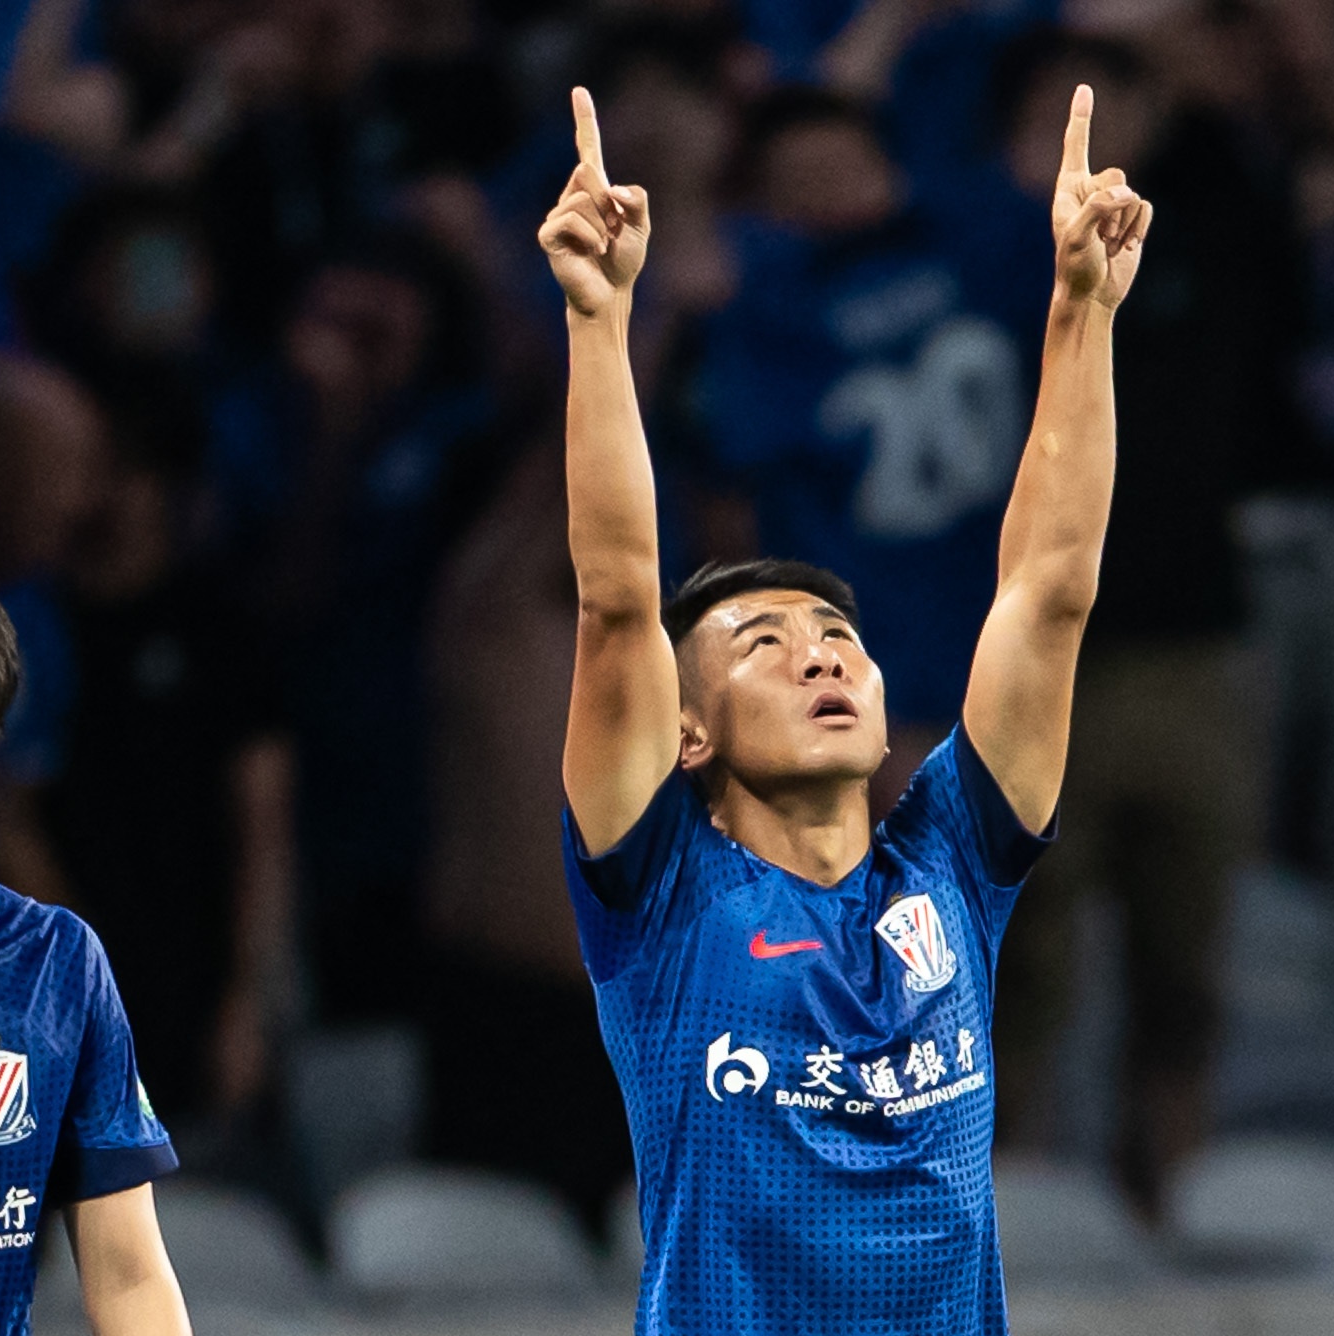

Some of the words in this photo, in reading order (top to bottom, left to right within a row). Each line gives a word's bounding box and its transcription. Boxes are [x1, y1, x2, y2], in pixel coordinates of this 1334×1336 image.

[800, 1028, 975, 1098] 交通銀行
[774, 1090, 836, 1111] BANK
[844, 1100, 876, 1115] OF
